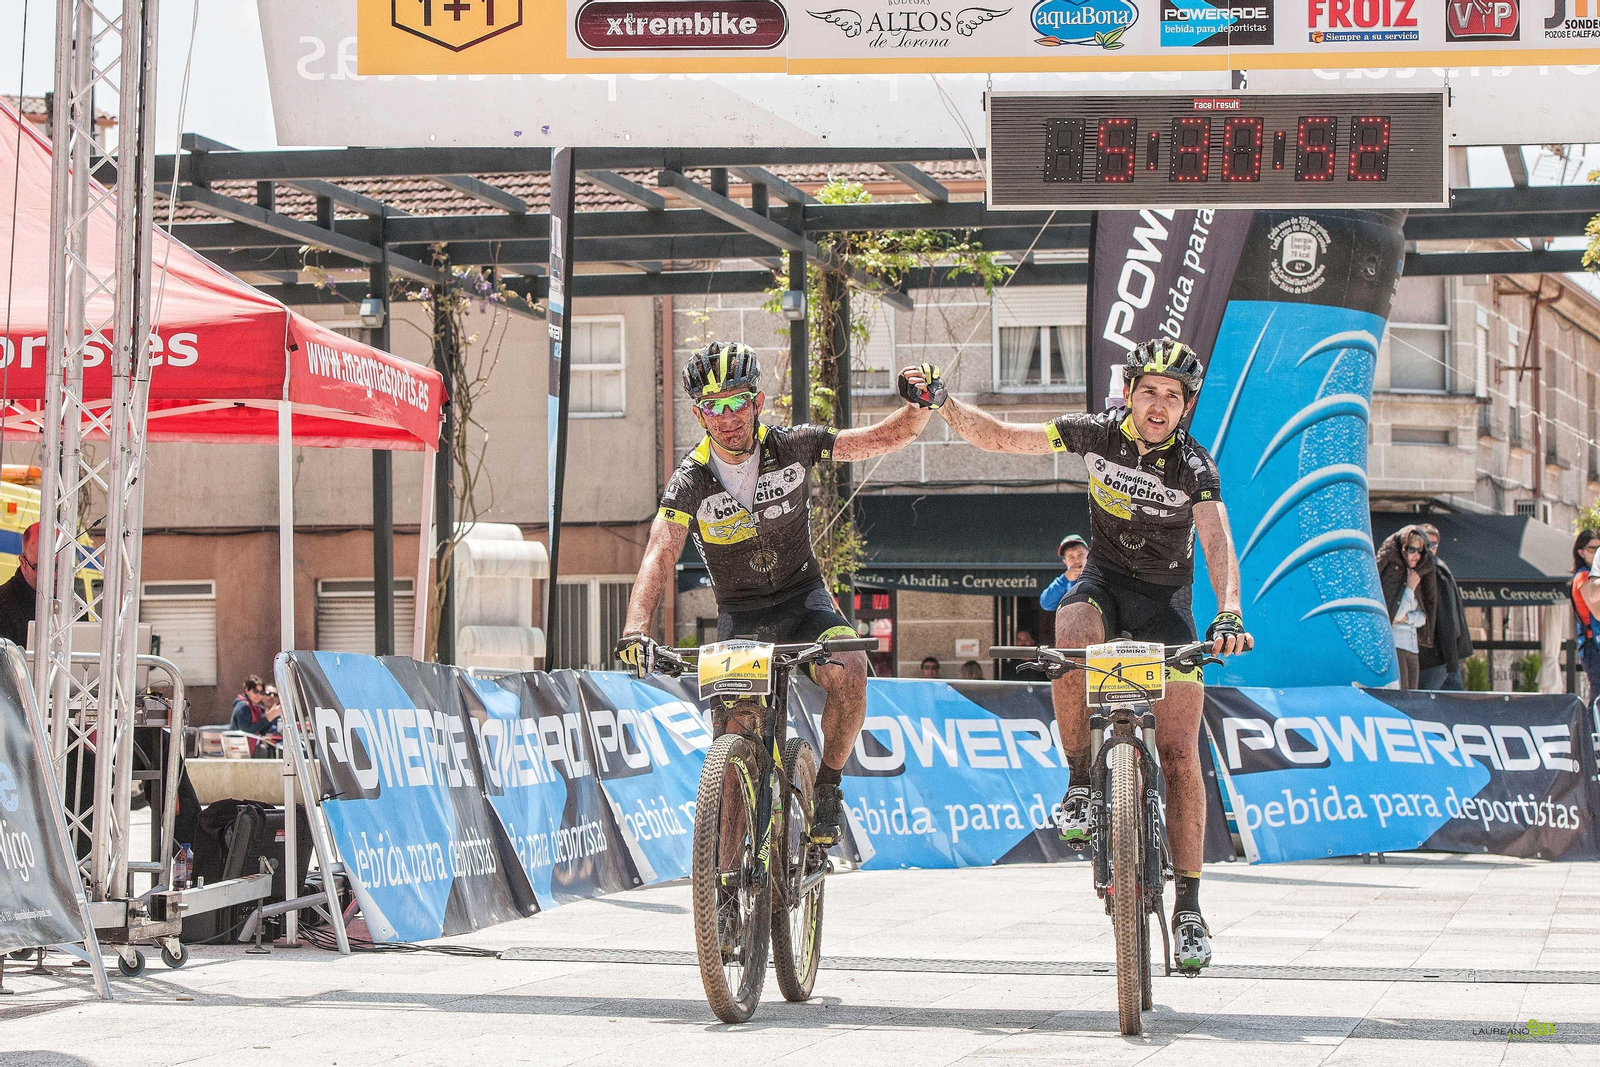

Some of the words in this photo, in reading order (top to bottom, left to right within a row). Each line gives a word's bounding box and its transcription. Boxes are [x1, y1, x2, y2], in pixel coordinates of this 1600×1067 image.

[606, 11, 758, 36] xtrembike
[866, 11, 952, 33] ALTOS
[1037, 7, 1130, 29] aquaBona
[1164, 7, 1267, 21] POWERADE
[1308, 0, 1418, 27] FROIZ
[1565, 19, 1600, 29] SONDE
[869, 33, 888, 48] de
[890, 27, 951, 48] Torona
[1165, 25, 1194, 34] bebida
[1196, 26, 1216, 35] para
[1217, 24, 1267, 35] deportistas
[1326, 32, 1361, 42] Siempre
[1385, 32, 1418, 41] servicio
[1544, 30, 1566, 39] POZOS
[1567, 30, 1571, 38] E
[1099, 118, 1390, 181] 5:30:52
[1102, 209, 1175, 350] POW
[1159, 276, 1194, 343] bida
[1183, 209, 1215, 275] para
[306, 341, 430, 413] www.magmasports.es
[1104, 474, 1165, 503] bandeira
[962, 575, 1038, 589] Cervecería
[1459, 587, 1496, 600] badia
[721, 657, 731, 672] 1
[752, 660, 761, 669] A
[1112, 662, 1122, 683] 1
[1146, 671, 1154, 680] B
[315, 707, 470, 789] POWERADE
[1222, 716, 1575, 773] POWERADE
[851, 797, 936, 836] ebida
[945, 800, 1024, 843] para
[1237, 786, 1367, 831] bebida
[1370, 792, 1441, 829] para
[1446, 786, 1580, 832] deportistas
[523, 832, 551, 883] para
[407, 840, 448, 898] para
